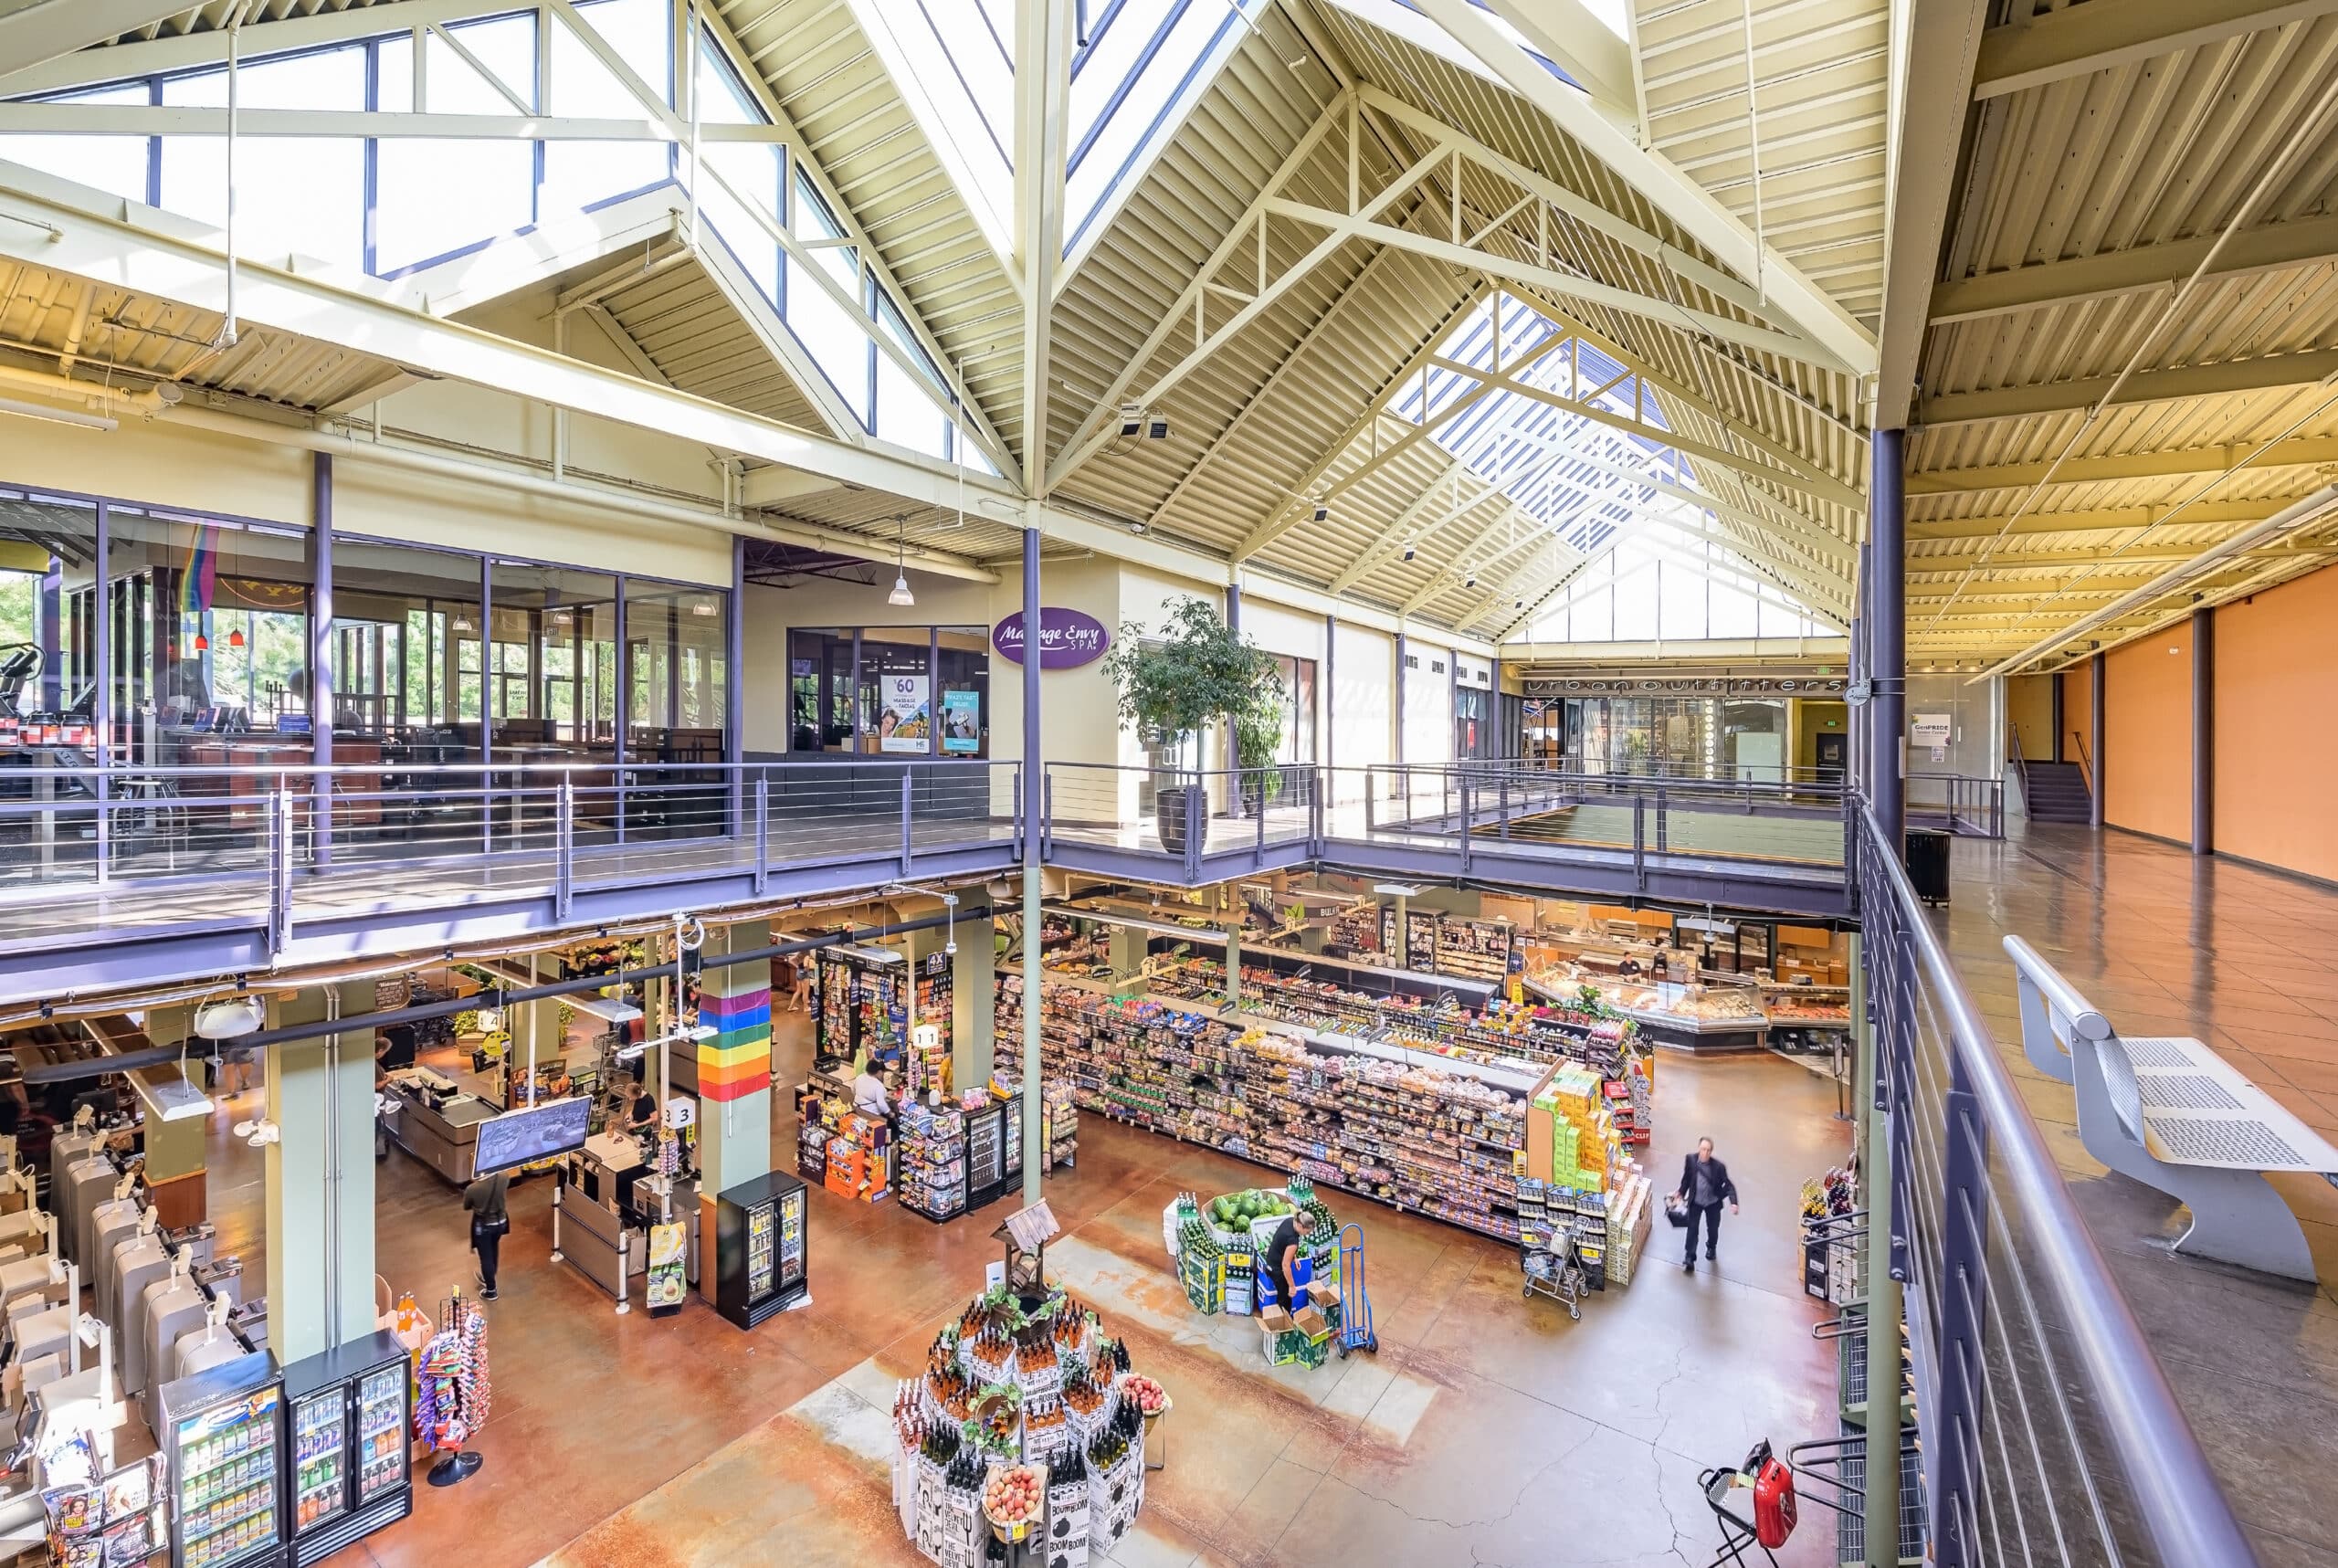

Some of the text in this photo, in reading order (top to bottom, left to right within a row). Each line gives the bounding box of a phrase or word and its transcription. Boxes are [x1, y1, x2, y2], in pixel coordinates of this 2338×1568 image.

[999, 625, 1100, 645] Maage Envy
[1070, 640, 1093, 650] SPA
[1527, 677, 1842, 692] urban outfitters
[665, 1109, 671, 1123] 3
[679, 1109, 690, 1122] 3
[945, 1540, 956, 1552] THE
[1049, 1539, 1069, 1552] BOOM
[945, 1549, 964, 1564] VELVET
